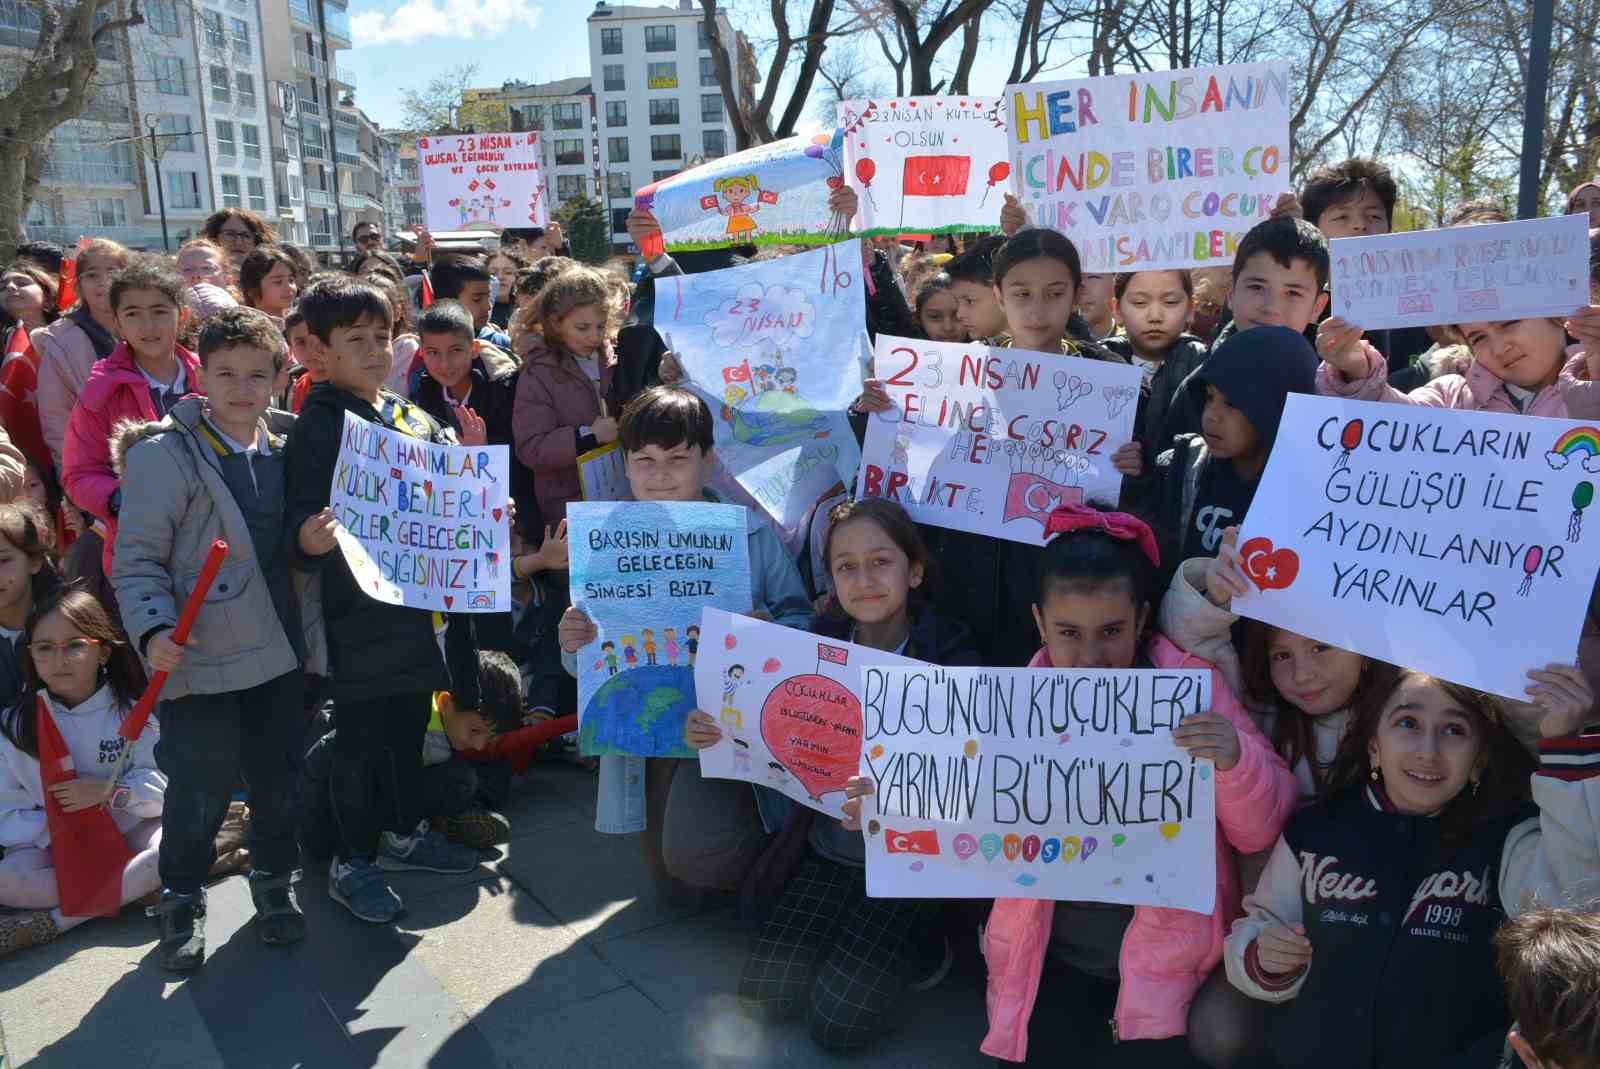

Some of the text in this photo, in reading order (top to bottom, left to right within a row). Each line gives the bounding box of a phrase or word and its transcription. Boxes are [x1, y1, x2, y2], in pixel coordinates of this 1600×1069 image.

[1014, 86, 1098, 144] HER
[456, 137, 476, 152] 23
[894, 130, 945, 148] OLSUN
[729, 298, 761, 315] 23
[886, 347, 944, 388] 23
[1326, 467, 1544, 514] GÜLÜŞÜ İLE
[588, 528, 733, 552] BARIŞIN UMUDUN
[1303, 511, 1565, 579] AYDINLANIYOR
[617, 553, 714, 573] GELECEĞİN
[585, 579, 715, 599] SİMGESİ BİZİZ
[1332, 562, 1497, 628] YARINLAR
[864, 668, 1203, 741] BUGÜNÜN KÜÇÜKLERİ
[864, 751, 1197, 826] YARININ BÜYÜKLERİ
[1300, 850, 1378, 904] New
[1424, 904, 1464, 928] 1998
